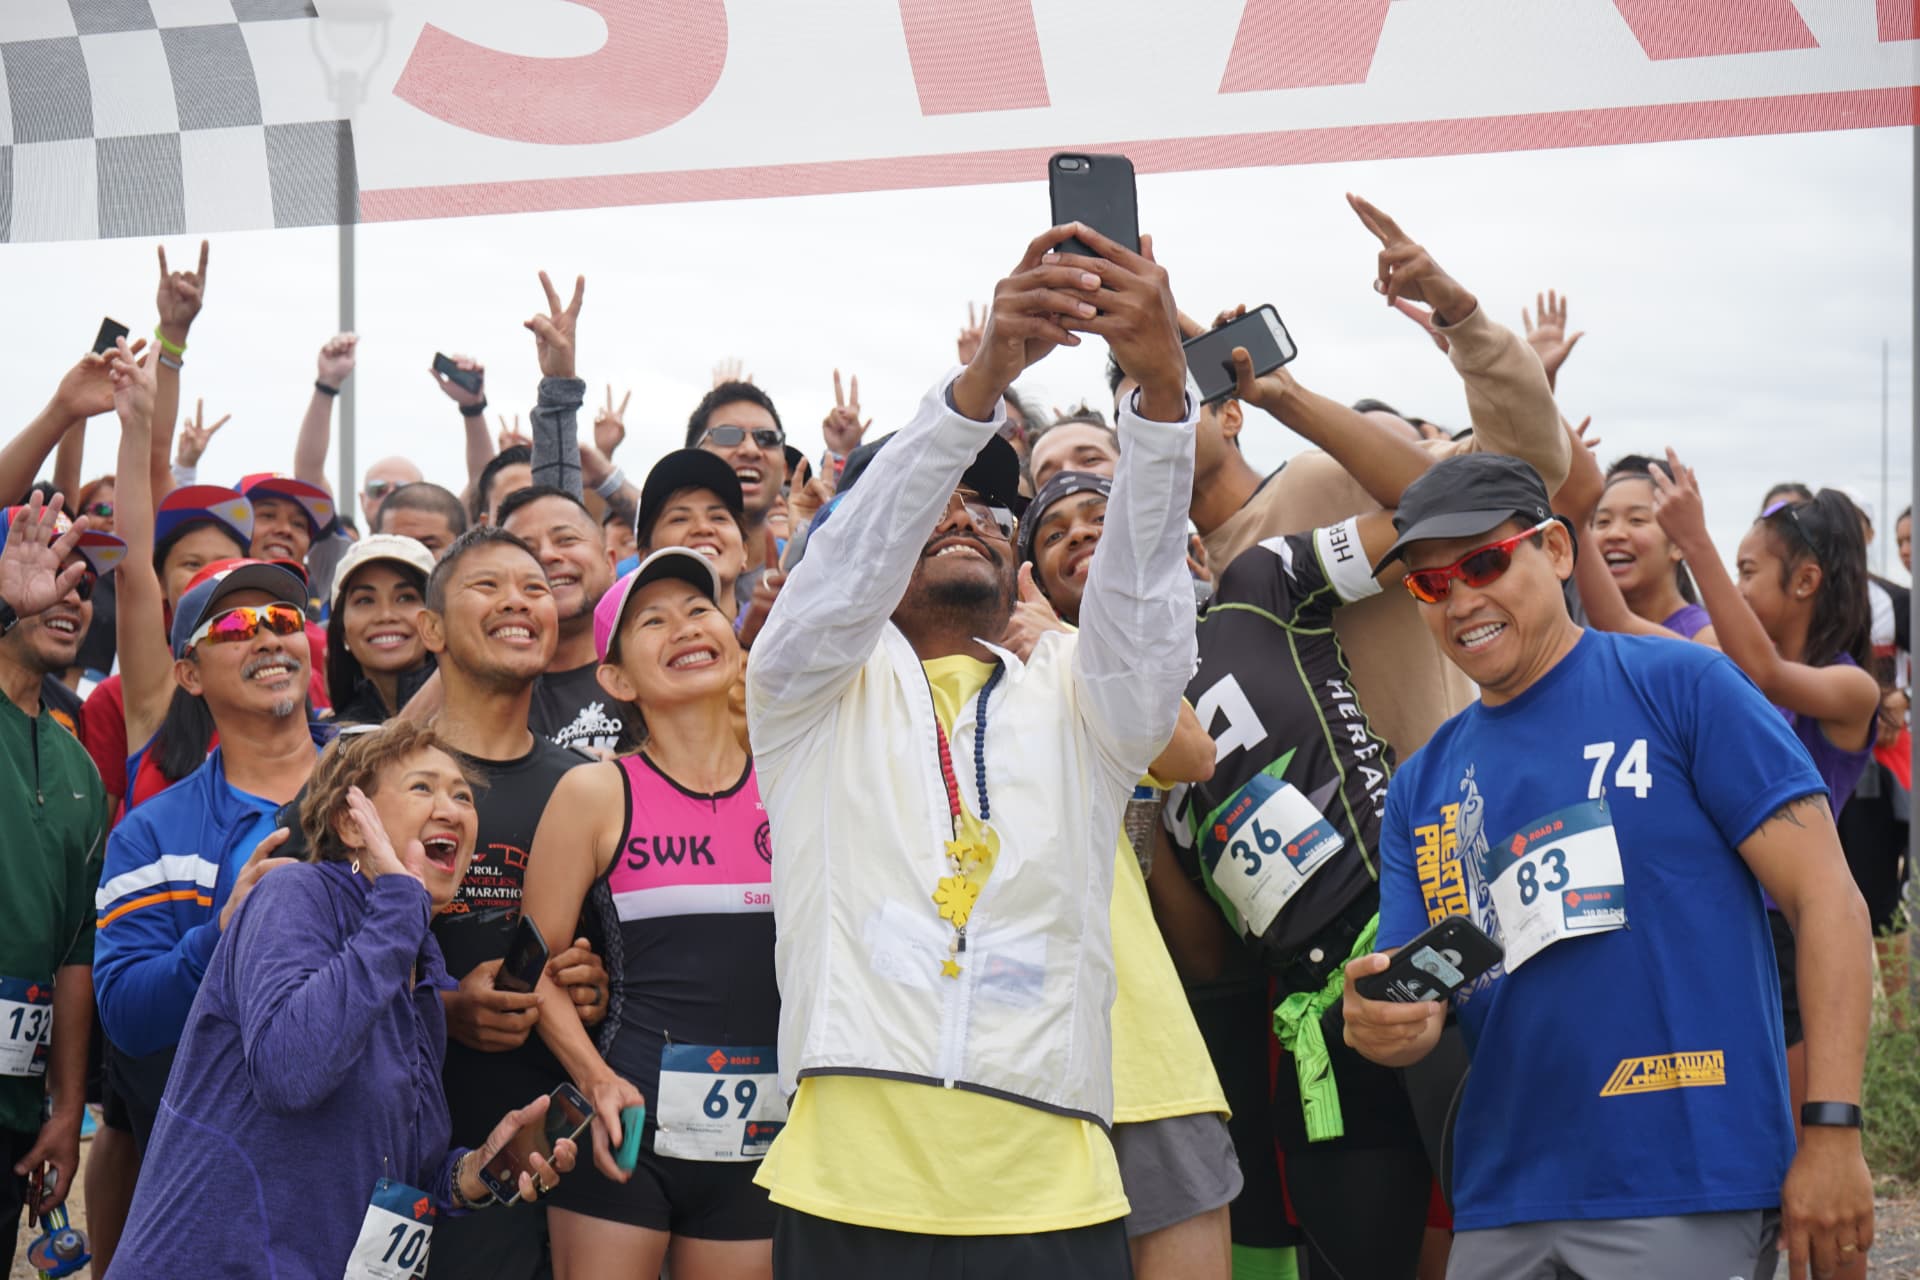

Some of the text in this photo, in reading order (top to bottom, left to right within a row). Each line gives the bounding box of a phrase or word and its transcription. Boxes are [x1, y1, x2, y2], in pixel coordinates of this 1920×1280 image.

[1583, 739, 1653, 799] 74
[1231, 817, 1282, 876] 36
[1528, 826, 1553, 842] ROAD
[474, 865, 503, 876] ROLL
[626, 835, 716, 871] SWK
[1517, 848, 1570, 906] 83
[743, 891, 771, 905] San
[10, 1006, 51, 1042] 132
[703, 1079, 758, 1120] 69
